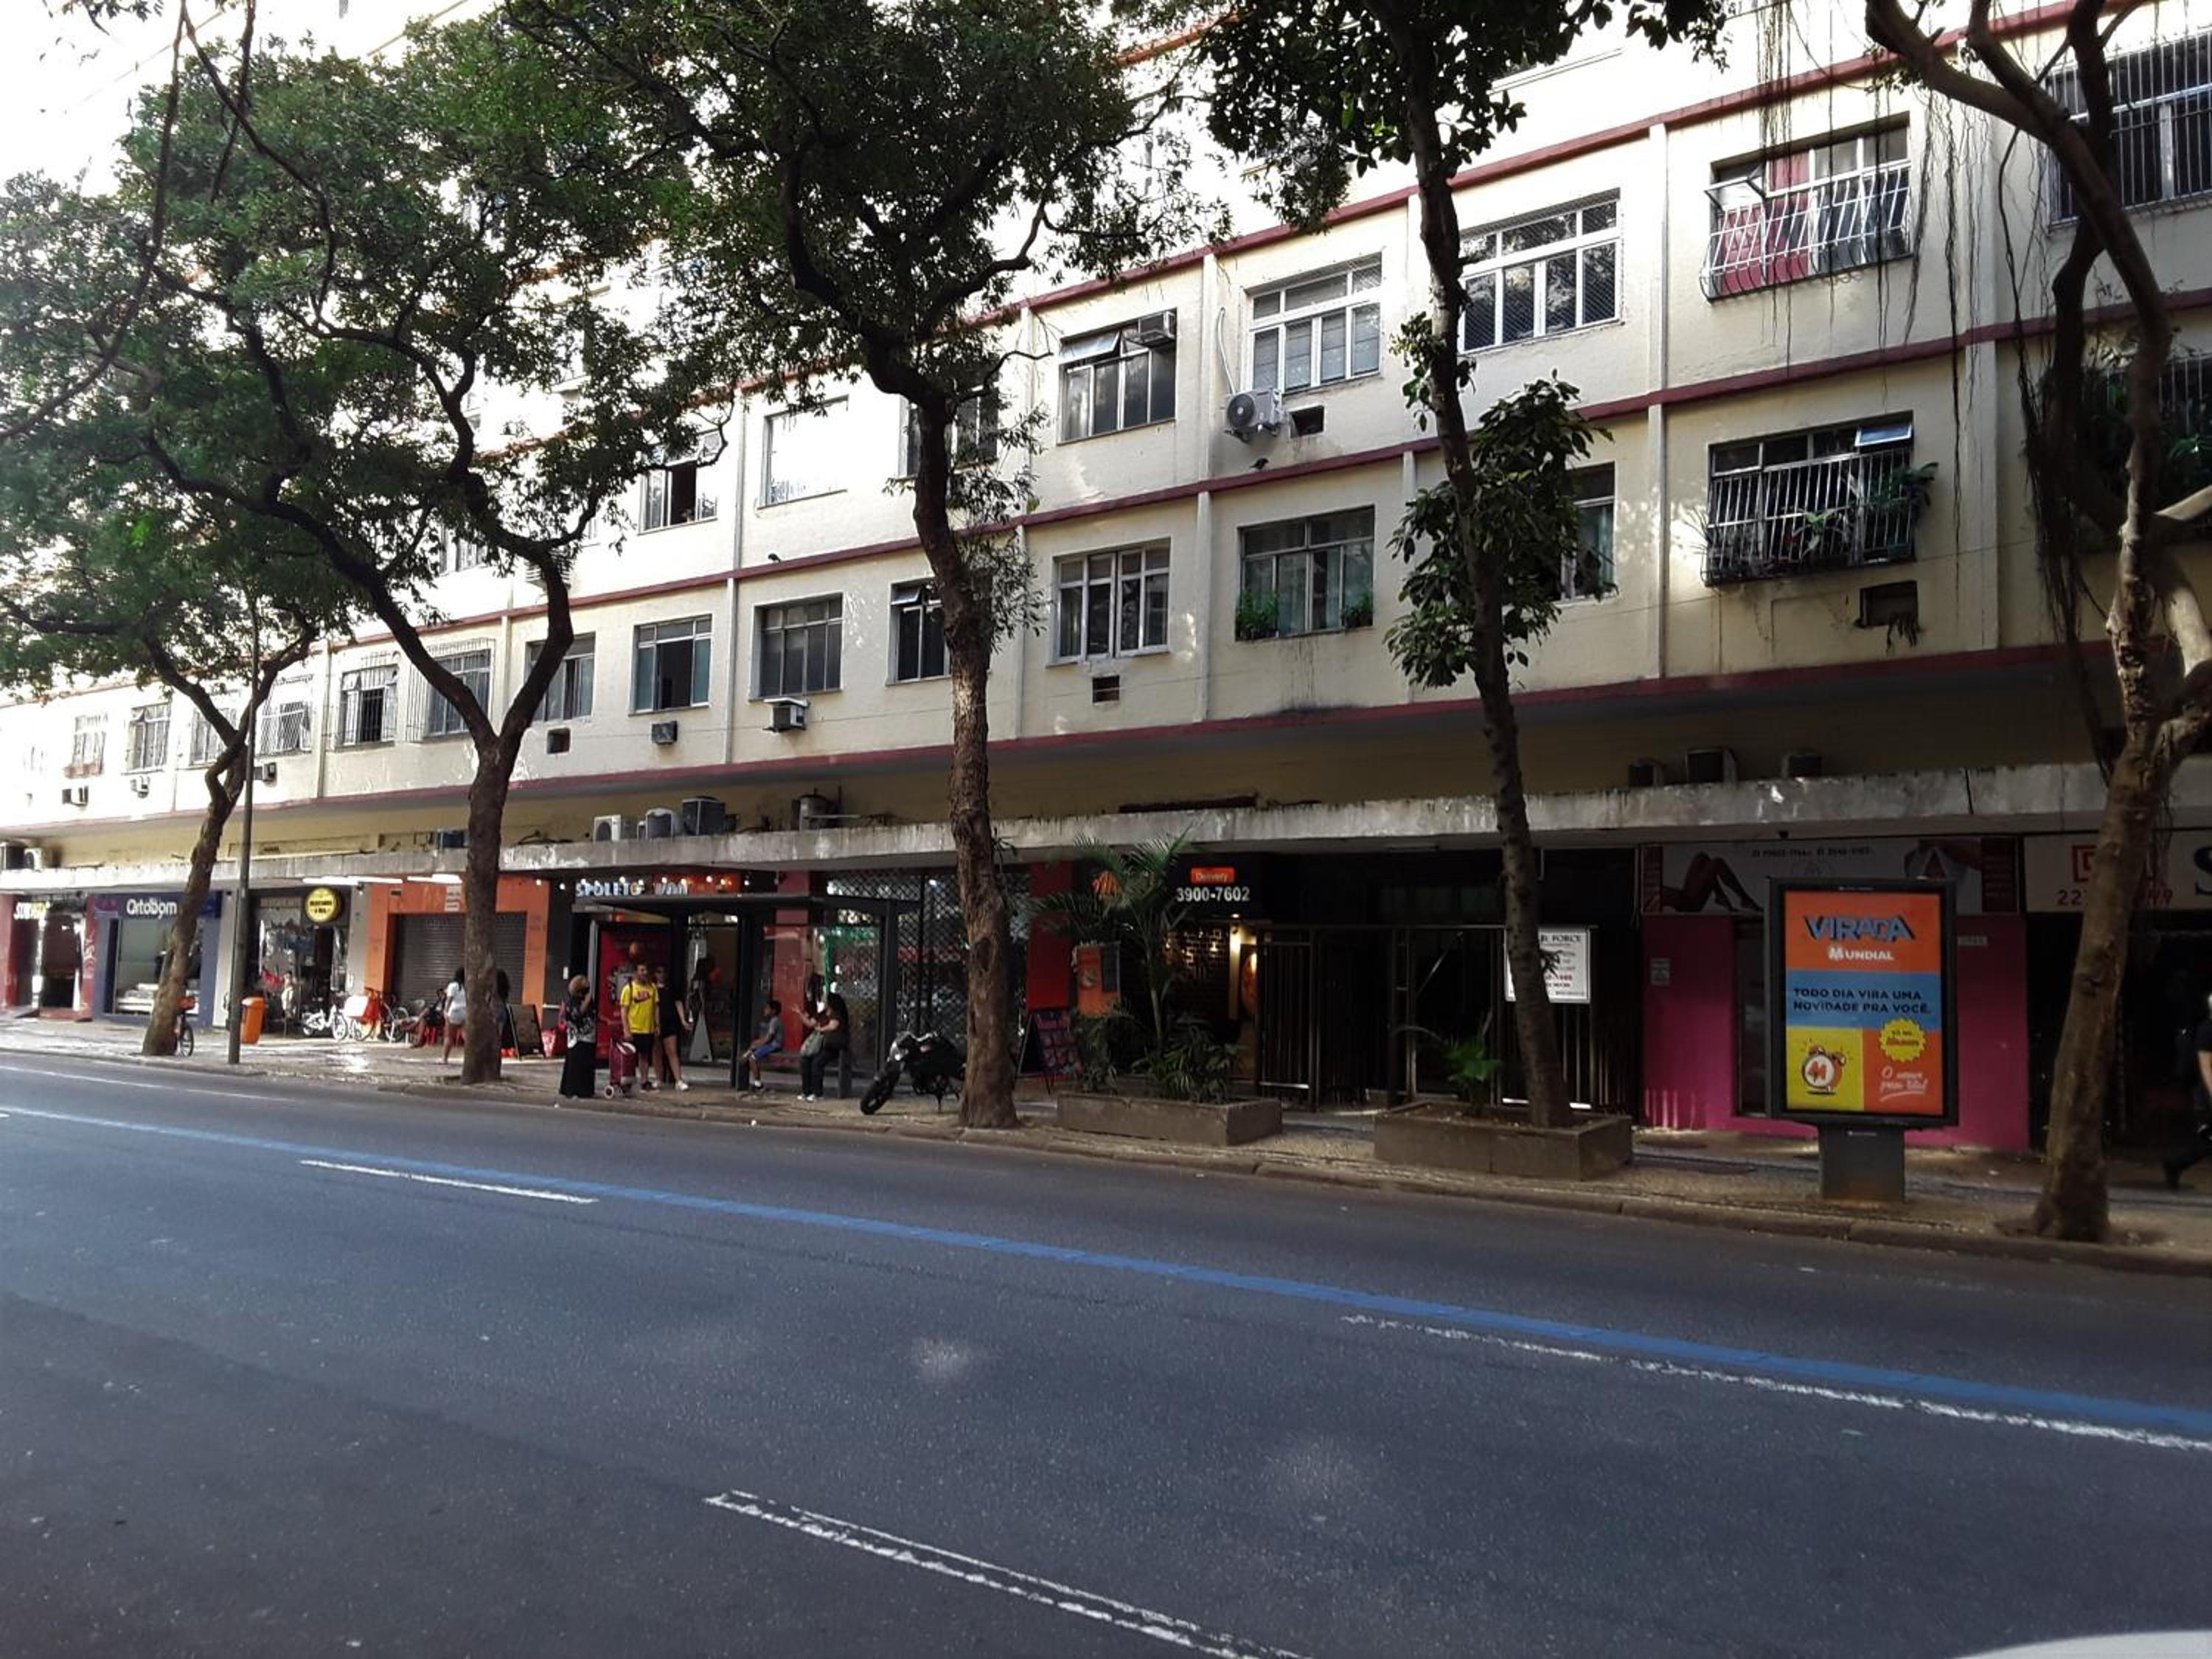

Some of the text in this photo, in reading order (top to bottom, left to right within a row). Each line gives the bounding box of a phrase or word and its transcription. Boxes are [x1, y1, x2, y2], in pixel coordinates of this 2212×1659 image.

[1176, 886, 1250, 902] 3900-7602
[1827, 946, 1895, 961] MUNDIAL
[1793, 988, 1922, 1001] TODO DIA VIRA UMA
[1793, 1001, 1859, 1012] NOVIDADE
[1863, 1003, 1889, 1013] PRA
